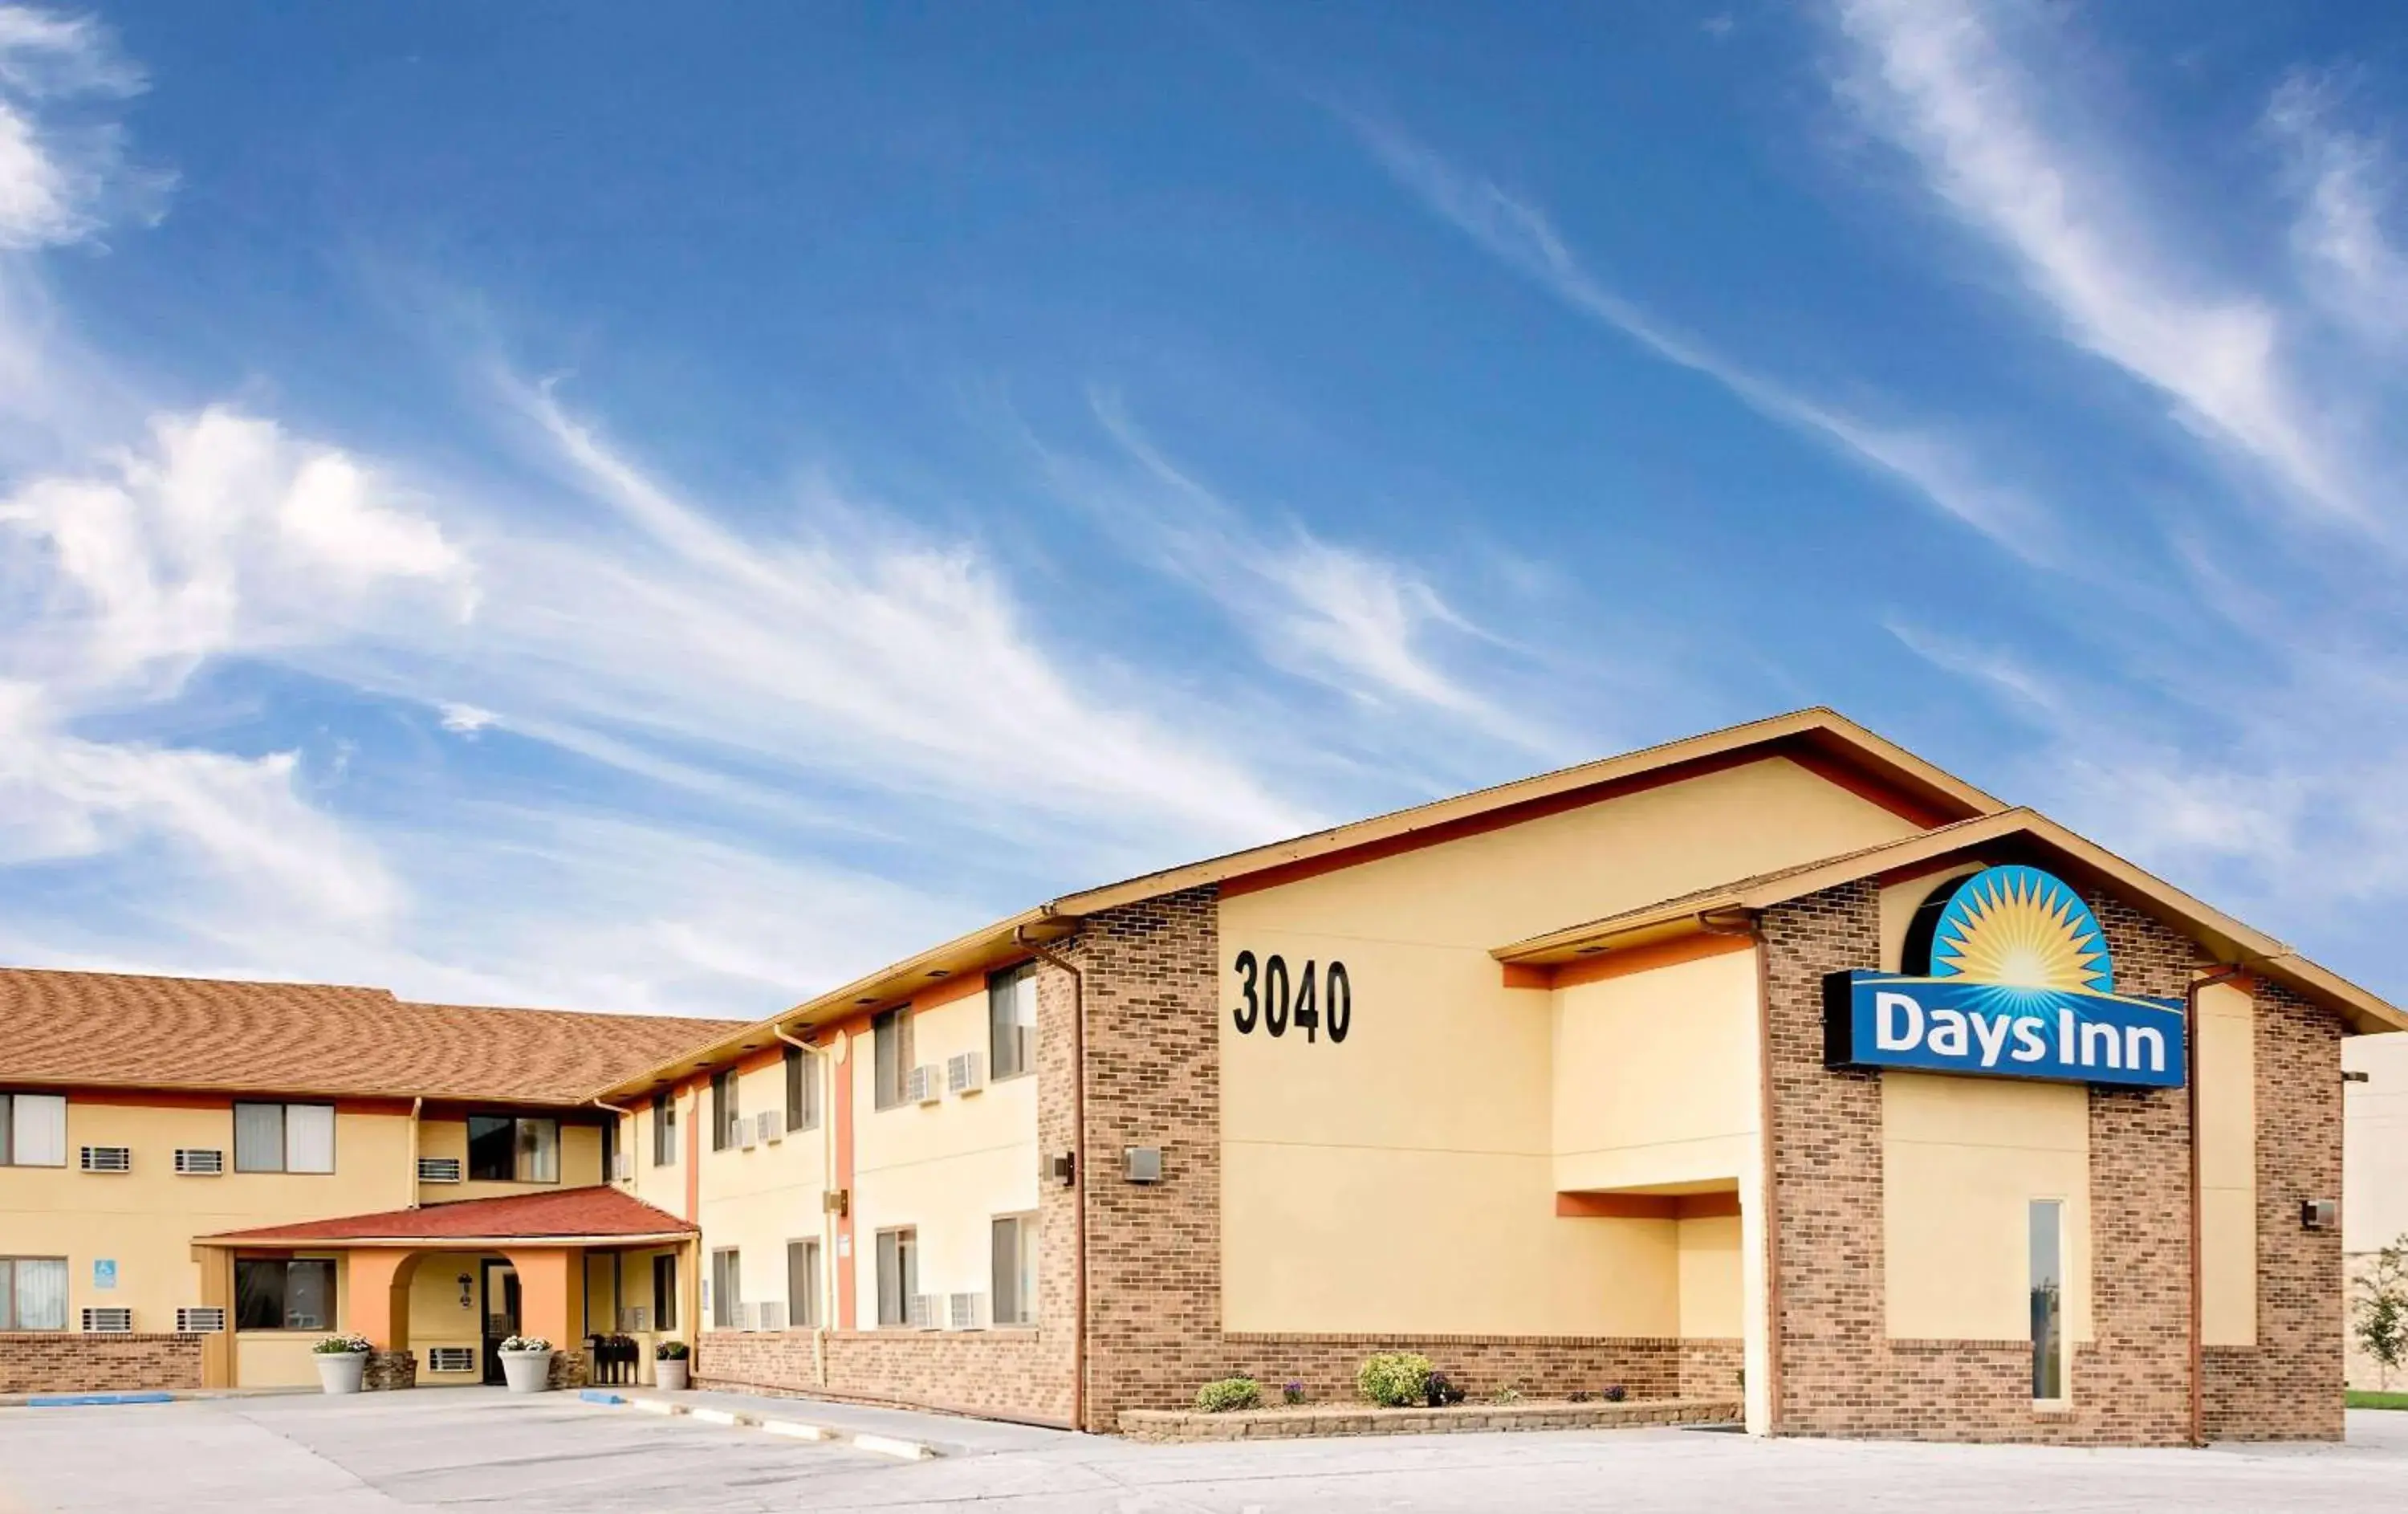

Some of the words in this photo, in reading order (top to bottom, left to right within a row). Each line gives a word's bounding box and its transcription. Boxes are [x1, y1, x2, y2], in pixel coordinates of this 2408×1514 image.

[1233, 950, 1351, 1044] 3040
[1875, 992, 2046, 1068] Days
[2058, 1007, 2166, 1072] Inn
